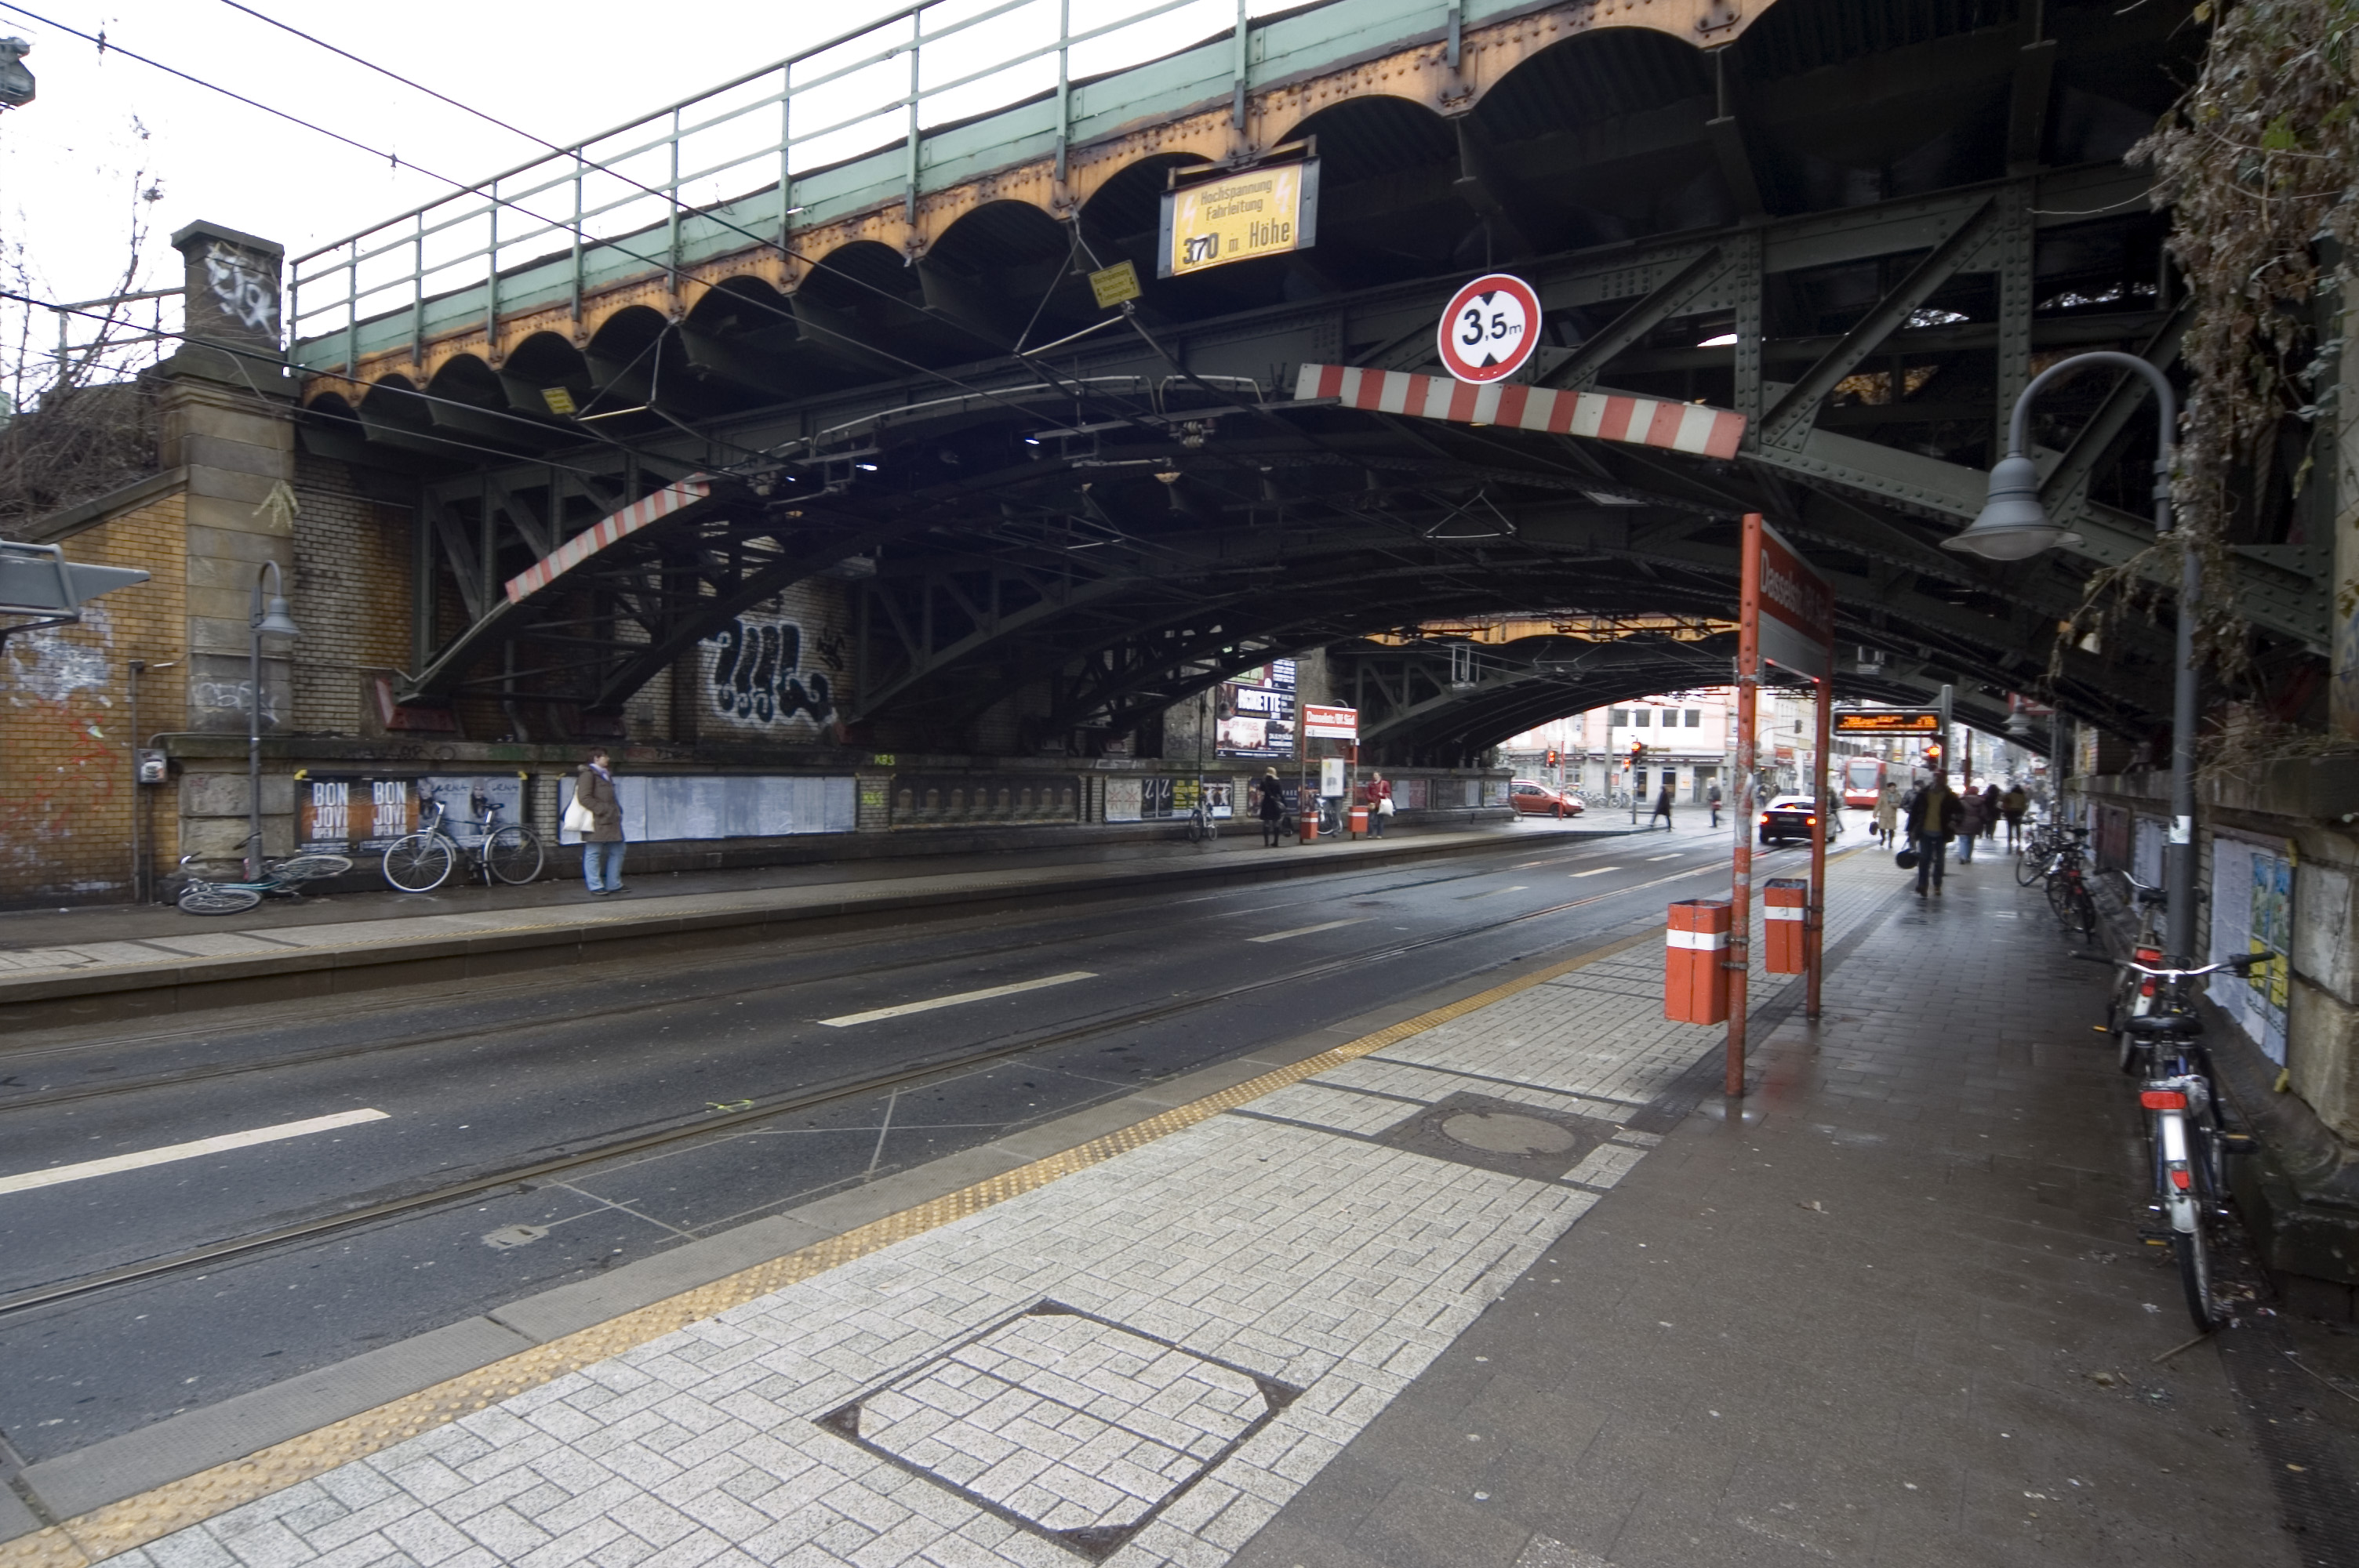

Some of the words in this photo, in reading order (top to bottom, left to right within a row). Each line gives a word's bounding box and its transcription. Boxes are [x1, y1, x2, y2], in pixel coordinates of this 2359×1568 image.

[1200, 180, 1273, 205] Hochspannung
[1205, 198, 1263, 220] Fahrleitung
[1228, 238, 1238, 252] m
[1249, 217, 1290, 249] Höhe
[313, 782, 349, 807] BON
[373, 781, 407, 805] BON
[312, 806, 349, 828] JOVI
[373, 804, 406, 826] JOVI
[312, 827, 334, 839] OPEN
[373, 824, 394, 837] OPEN
